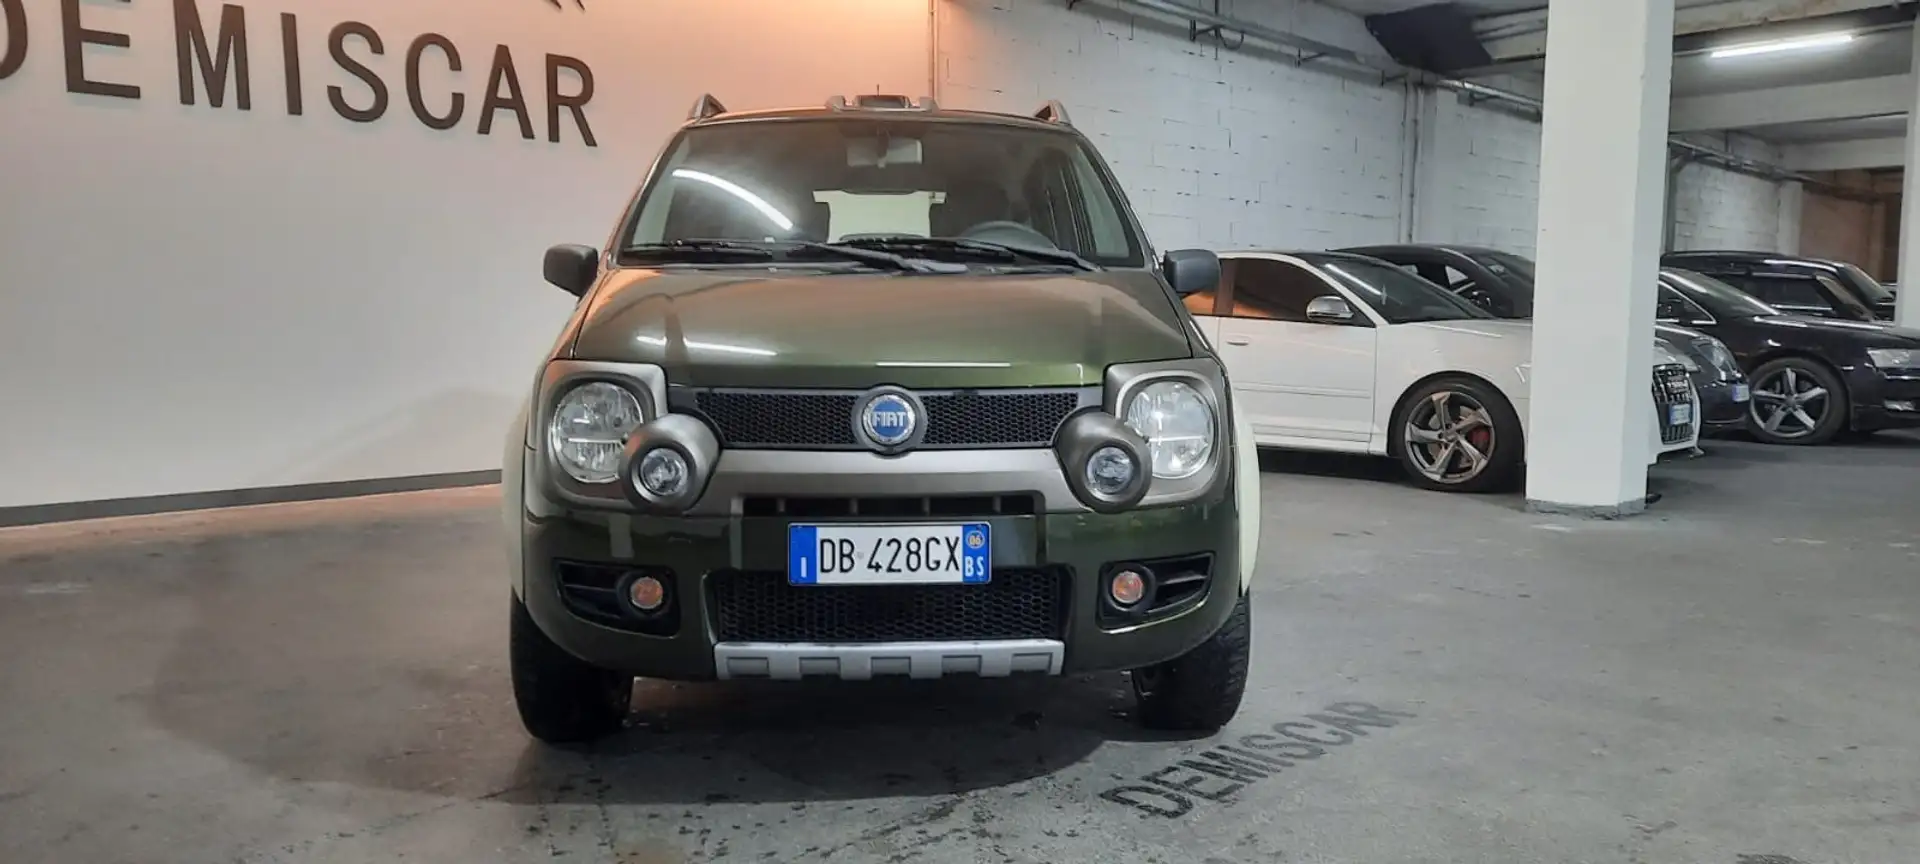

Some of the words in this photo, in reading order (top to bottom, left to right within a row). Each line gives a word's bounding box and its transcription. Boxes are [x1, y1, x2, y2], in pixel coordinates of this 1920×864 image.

[872, 411, 907, 427] FIAT
[819, 538, 856, 574] DB
[866, 536, 960, 573] 428GX
[964, 555, 985, 577] BS
[1099, 701, 1418, 819] DEMISCAR
